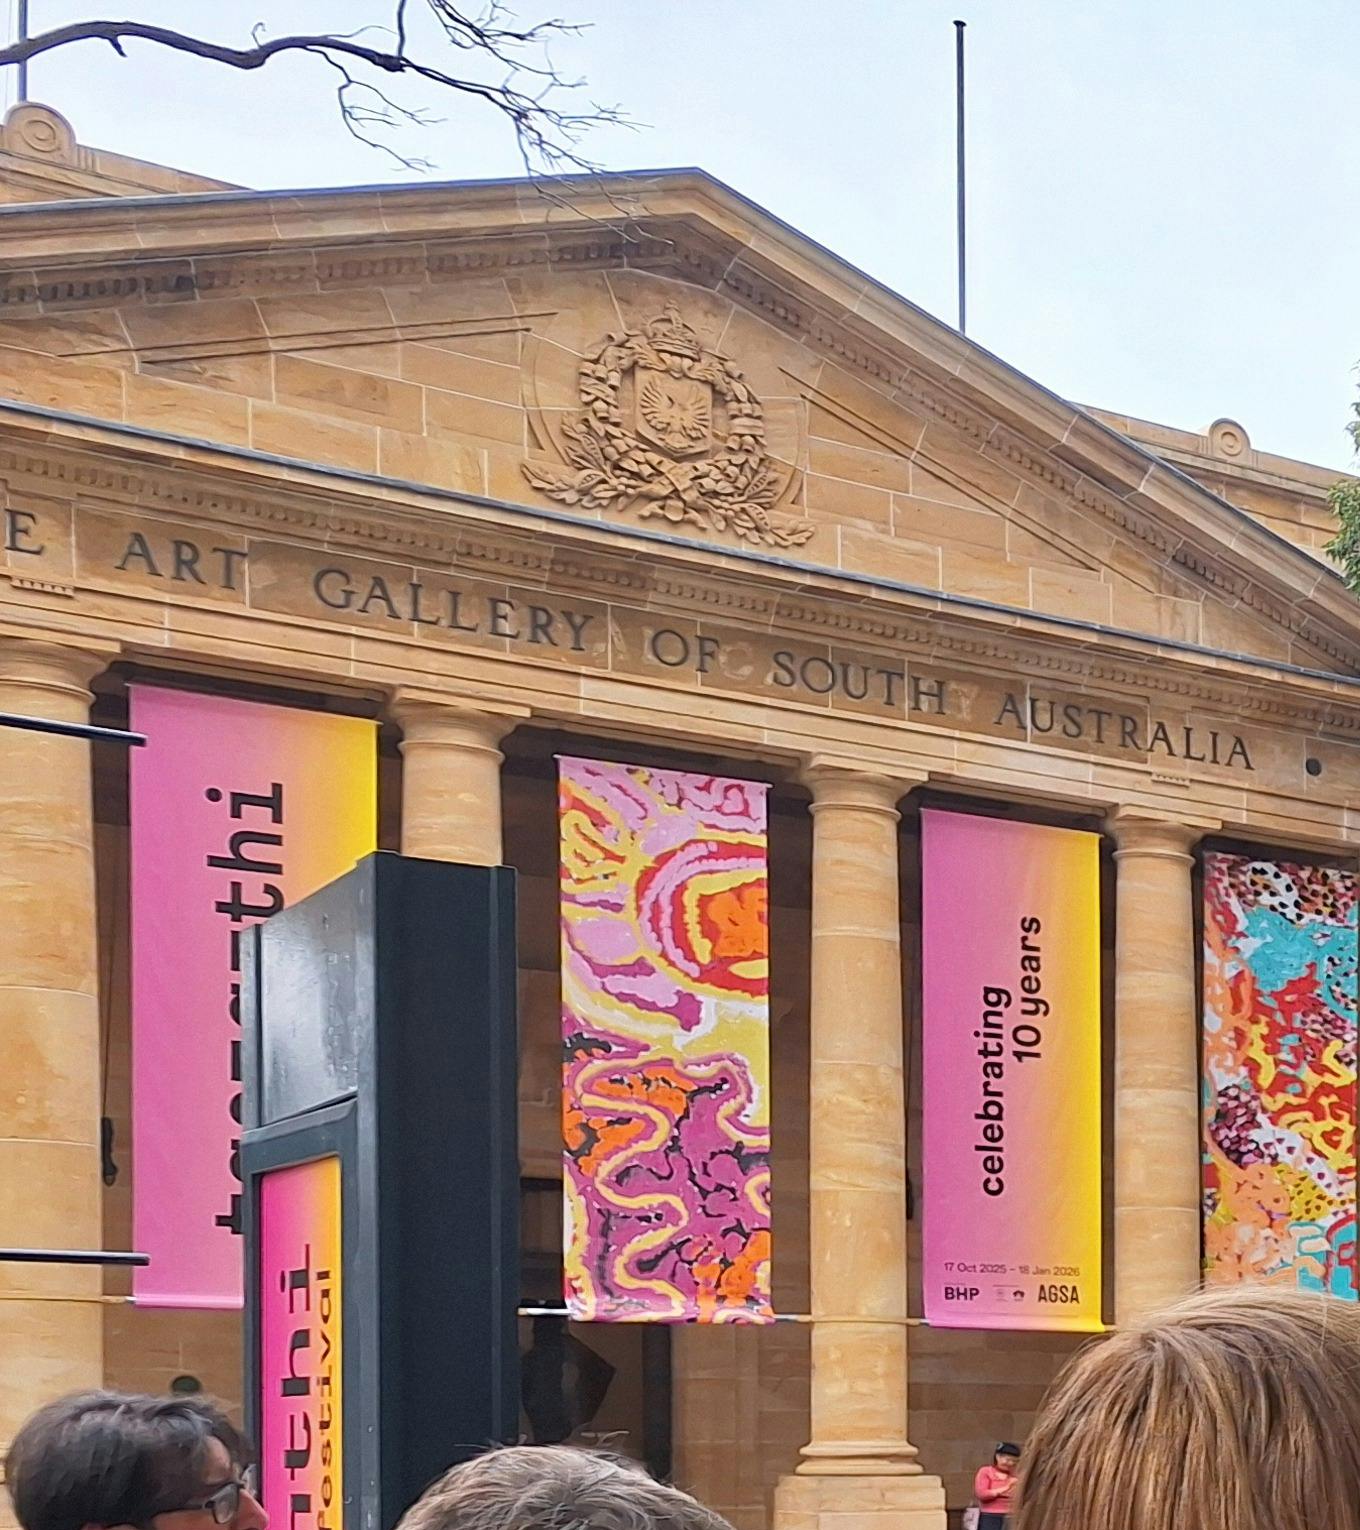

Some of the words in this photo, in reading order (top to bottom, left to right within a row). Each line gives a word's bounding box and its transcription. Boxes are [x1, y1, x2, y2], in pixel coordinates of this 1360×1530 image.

[114, 532, 249, 591] ART
[313, 567, 595, 652] GALLERY
[650, 628, 723, 674] OF
[772, 651, 947, 716] SOUTH
[994, 691, 1256, 772] AUSTRALIA
[1019, 915, 1051, 1017] years
[1012, 1024, 1042, 1063] 10
[973, 985, 1012, 1197] celebrating
[944, 1262, 955, 1272] 17
[957, 1262, 977, 1273] Oct
[979, 1263, 1007, 1274] 2025
[1032, 1265, 1051, 1276] Jan
[1053, 1266, 1081, 1277] 2026
[944, 1286, 980, 1301] BHP
[1037, 1284, 1081, 1304] AGSA
